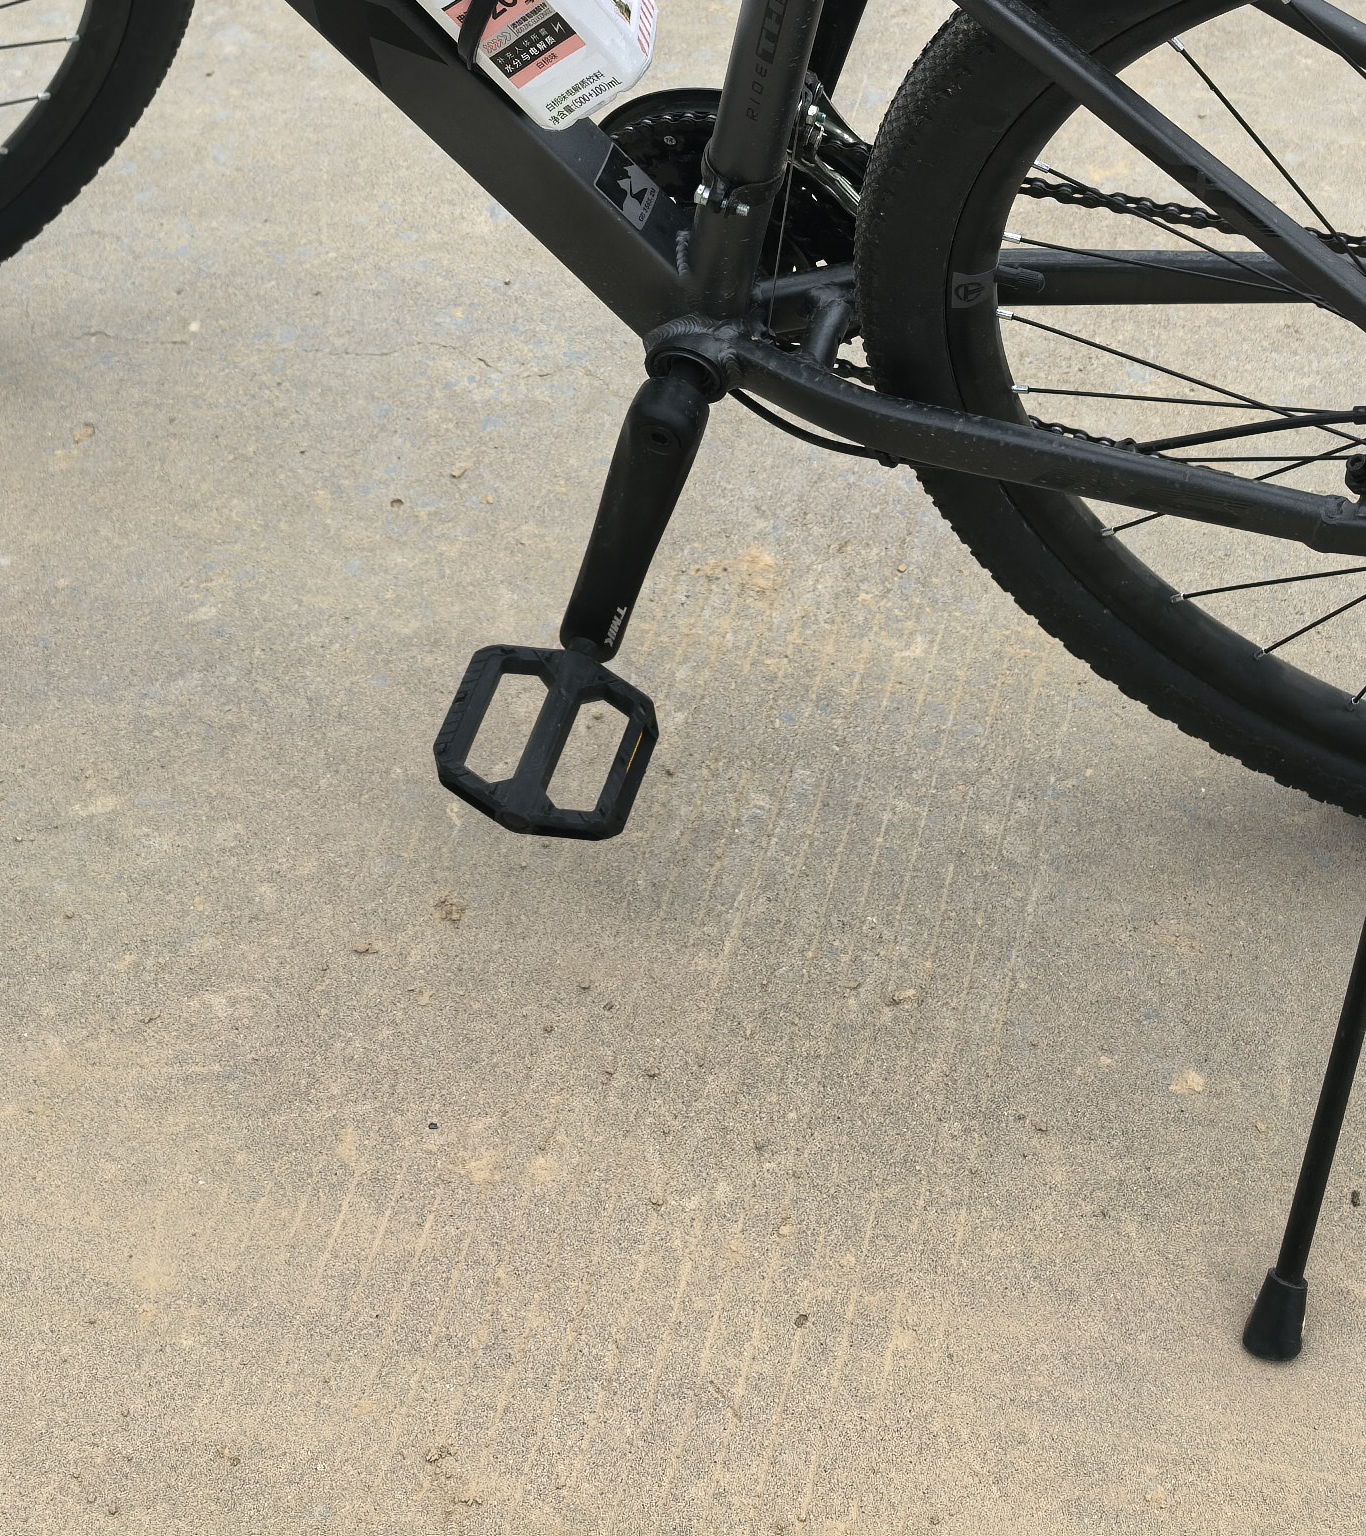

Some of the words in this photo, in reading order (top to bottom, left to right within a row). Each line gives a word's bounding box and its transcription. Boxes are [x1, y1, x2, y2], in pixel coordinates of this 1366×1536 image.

[504, 34, 557, 74] 水分与电解质
[545, 70, 605, 113] 白桃味电解质饮料
